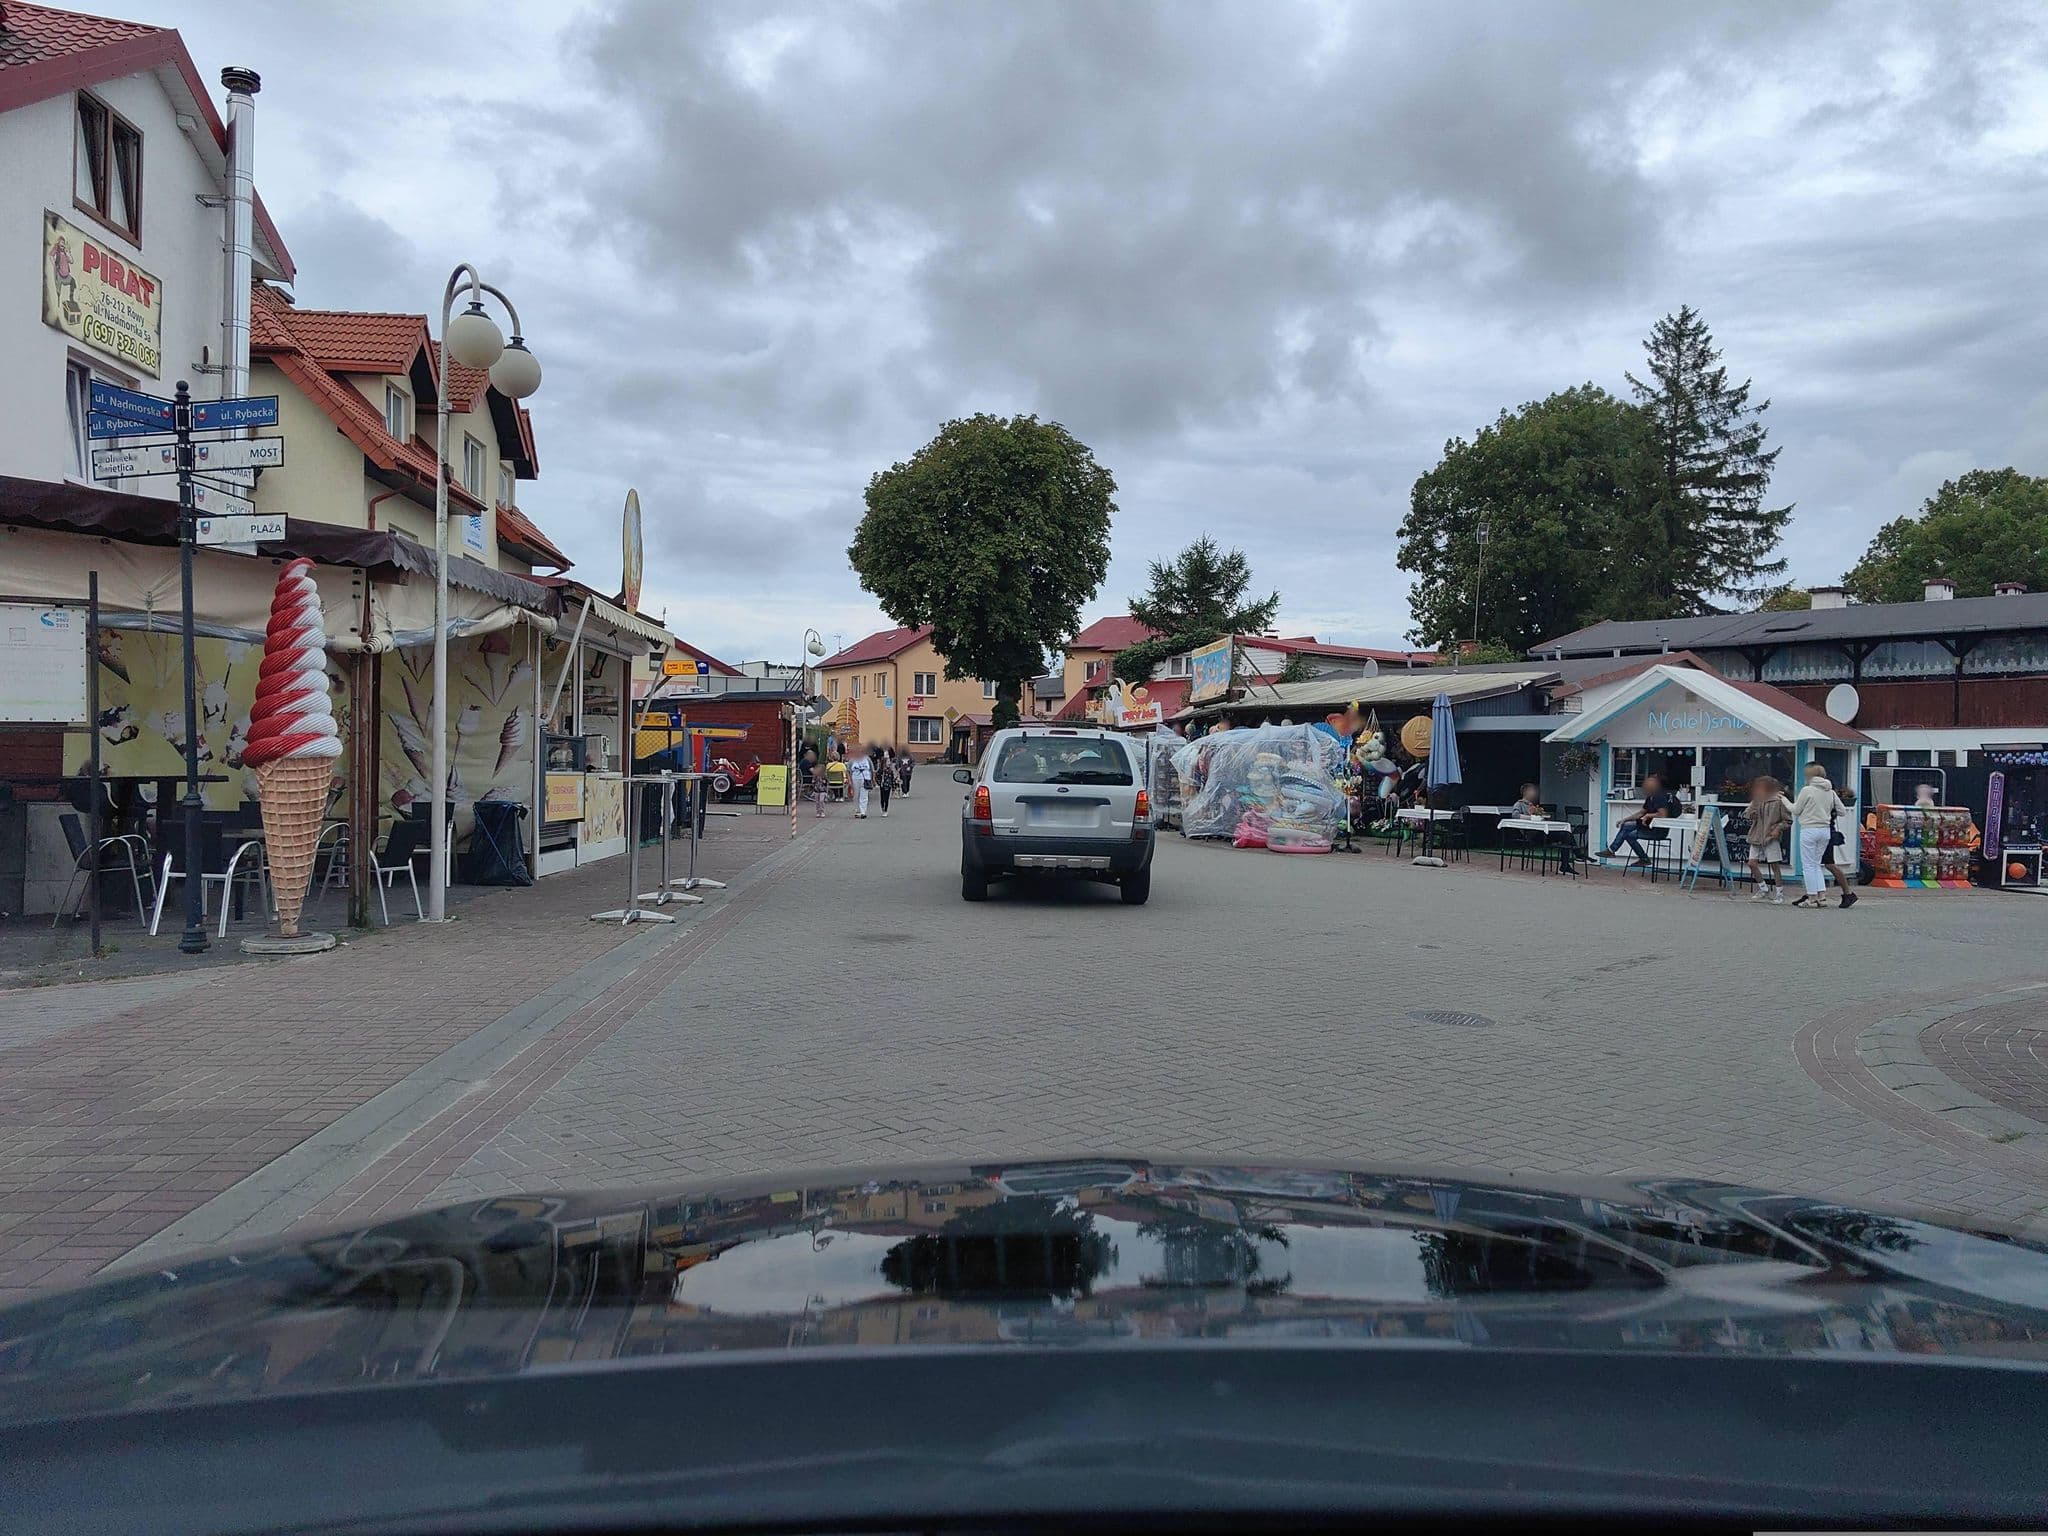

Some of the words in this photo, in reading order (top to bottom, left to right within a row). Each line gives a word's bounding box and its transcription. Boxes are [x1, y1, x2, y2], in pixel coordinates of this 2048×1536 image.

[83, 241, 155, 308] PIRAT
[101, 291, 125, 314] 76-212
[127, 305, 145, 328] Rowy
[104, 308, 143, 338] Nadmorska
[93, 319, 116, 347] 697
[117, 330, 138, 359] 322
[138, 342, 156, 369] 068
[95, 394, 107, 404] ul.
[109, 396, 161, 418] Nadmorska
[221, 410, 233, 420] ul.
[235, 407, 274, 421] Rybacka
[92, 422, 104, 431] ul.
[249, 447, 278, 458] MOST
[97, 463, 134, 473] ietlica
[250, 521, 282, 533] PLAŻA
